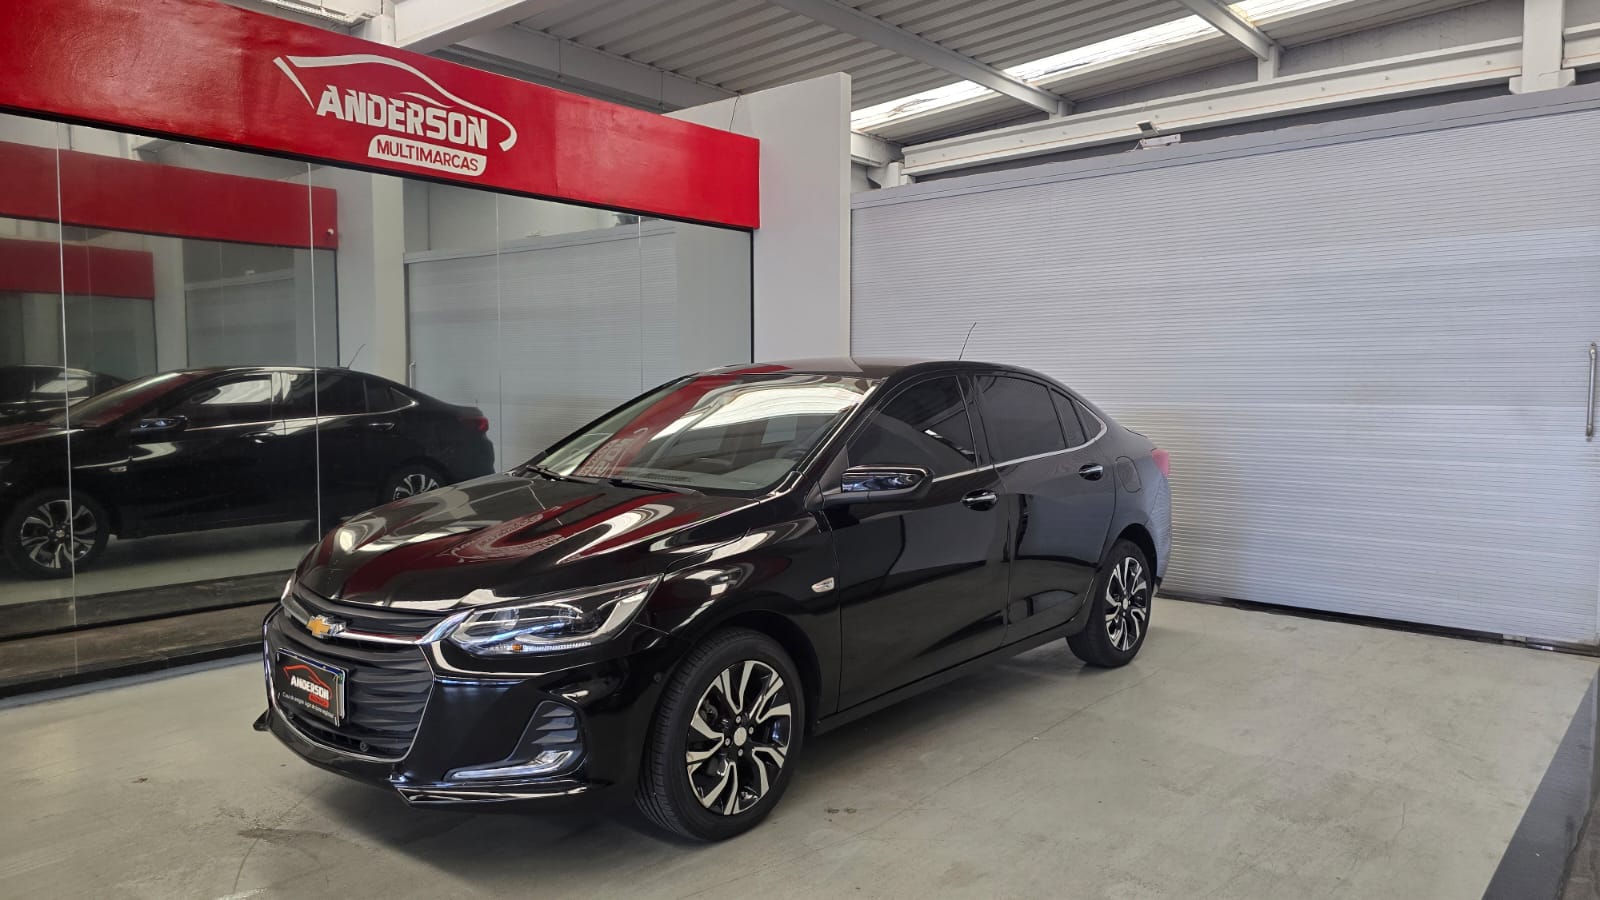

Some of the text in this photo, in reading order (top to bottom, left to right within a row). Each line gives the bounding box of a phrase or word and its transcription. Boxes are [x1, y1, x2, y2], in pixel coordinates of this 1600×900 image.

[316, 85, 488, 150] ANDERSON
[376, 139, 479, 172] MULTIMARCAS
[290, 675, 330, 700] ANDERSON
